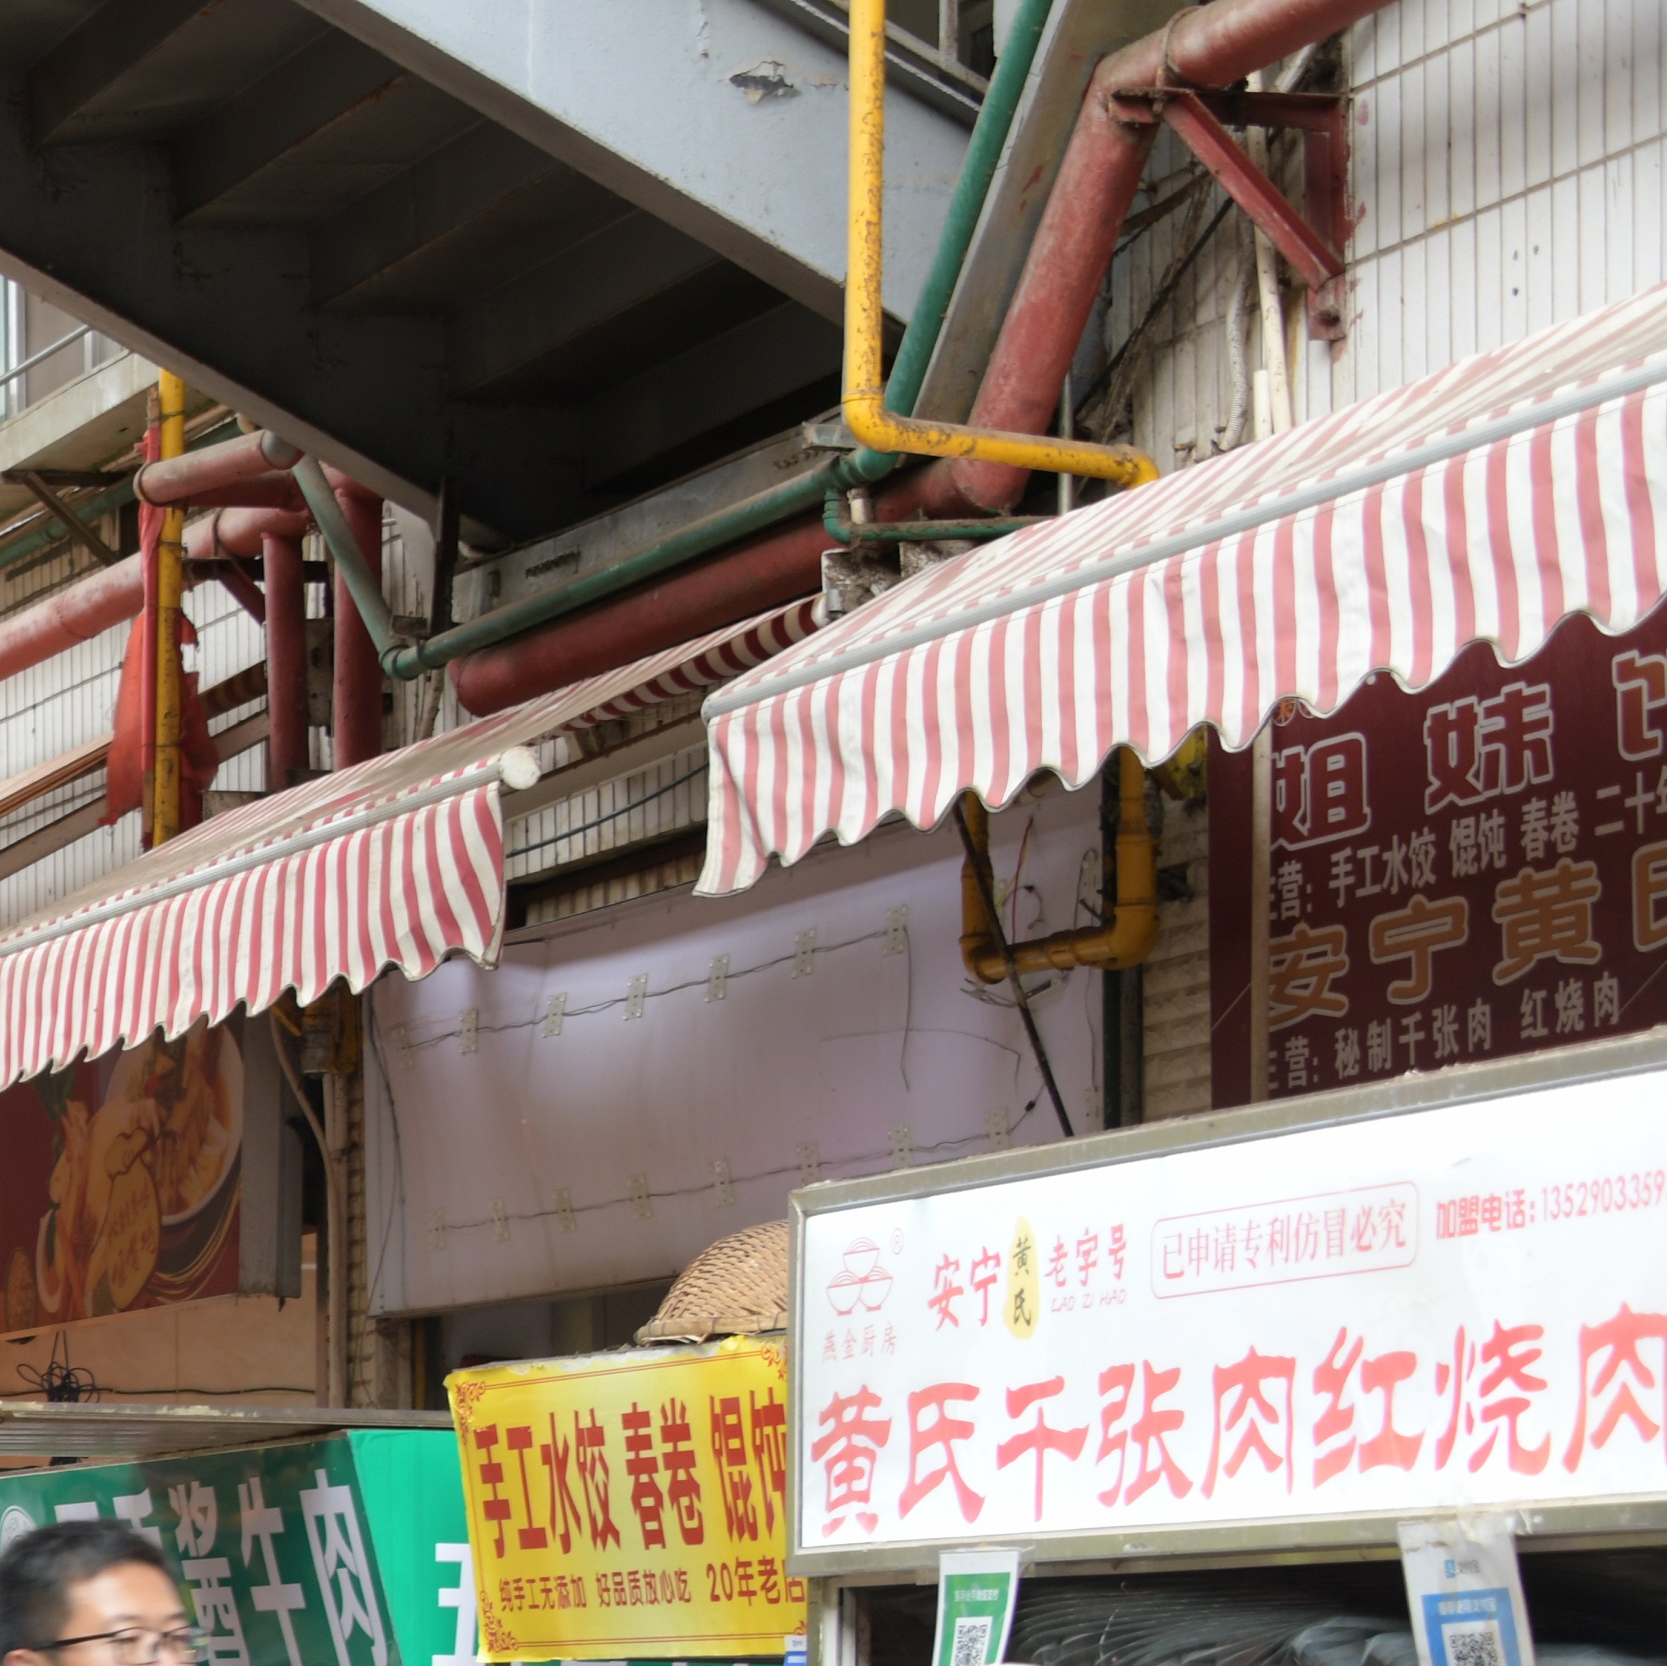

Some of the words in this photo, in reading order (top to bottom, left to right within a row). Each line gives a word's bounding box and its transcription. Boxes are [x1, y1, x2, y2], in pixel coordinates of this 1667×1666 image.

[1329, 830, 1437, 909] 手工水饺
[1449, 812, 1507, 879] 馄饨
[1520, 791, 1579, 862] 春卷
[1334, 998, 1492, 1075] 秘制千张肉
[1519, 972, 1620, 1038] 红烧肉
[1541, 1168, 1667, 1222] 1352903359
[1044, 1224, 1128, 1289] 老字号
[1162, 1198, 1407, 1281] 已申请专利仿冒必究
[927, 1245, 1001, 1332] 安宁
[473, 1408, 621, 1559] 手工水饺
[622, 1397, 704, 1549] 春卷
[709, 1387, 787, 1542] 馄饨
[499, 1574, 587, 1612] 纯手工无添加
[595, 1567, 692, 1607] 好品质放心吃
